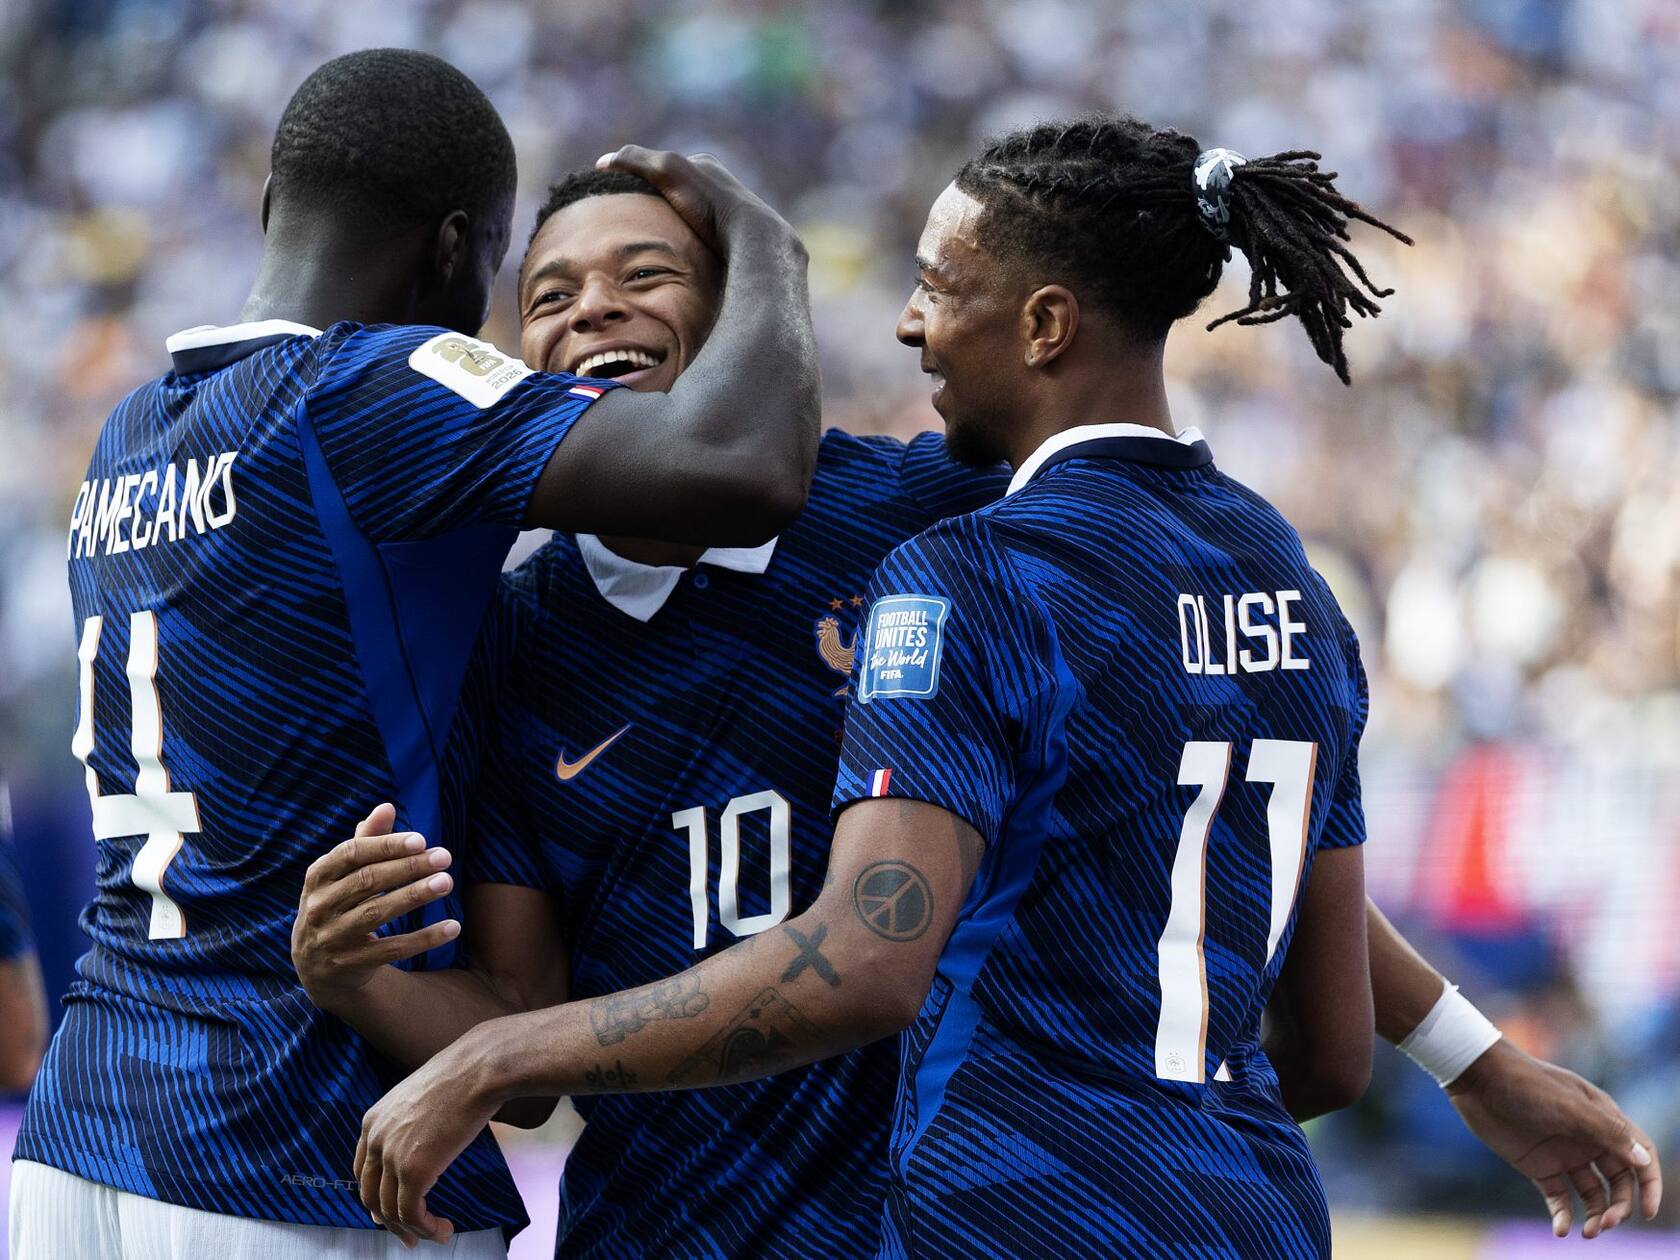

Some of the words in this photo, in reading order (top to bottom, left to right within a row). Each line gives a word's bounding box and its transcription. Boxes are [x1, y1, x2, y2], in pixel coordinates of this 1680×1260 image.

[491, 369, 523, 389] 2026
[877, 610, 928, 628] FOOTBALL
[874, 627, 928, 650] UNITES
[1177, 590, 1310, 675] OLISE
[870, 650, 886, 671] the
[887, 648, 928, 668] World
[880, 670, 902, 680] FIFA
[71, 609, 203, 940] 4
[672, 789, 792, 950] 10
[1155, 738, 1319, 1084] 11
